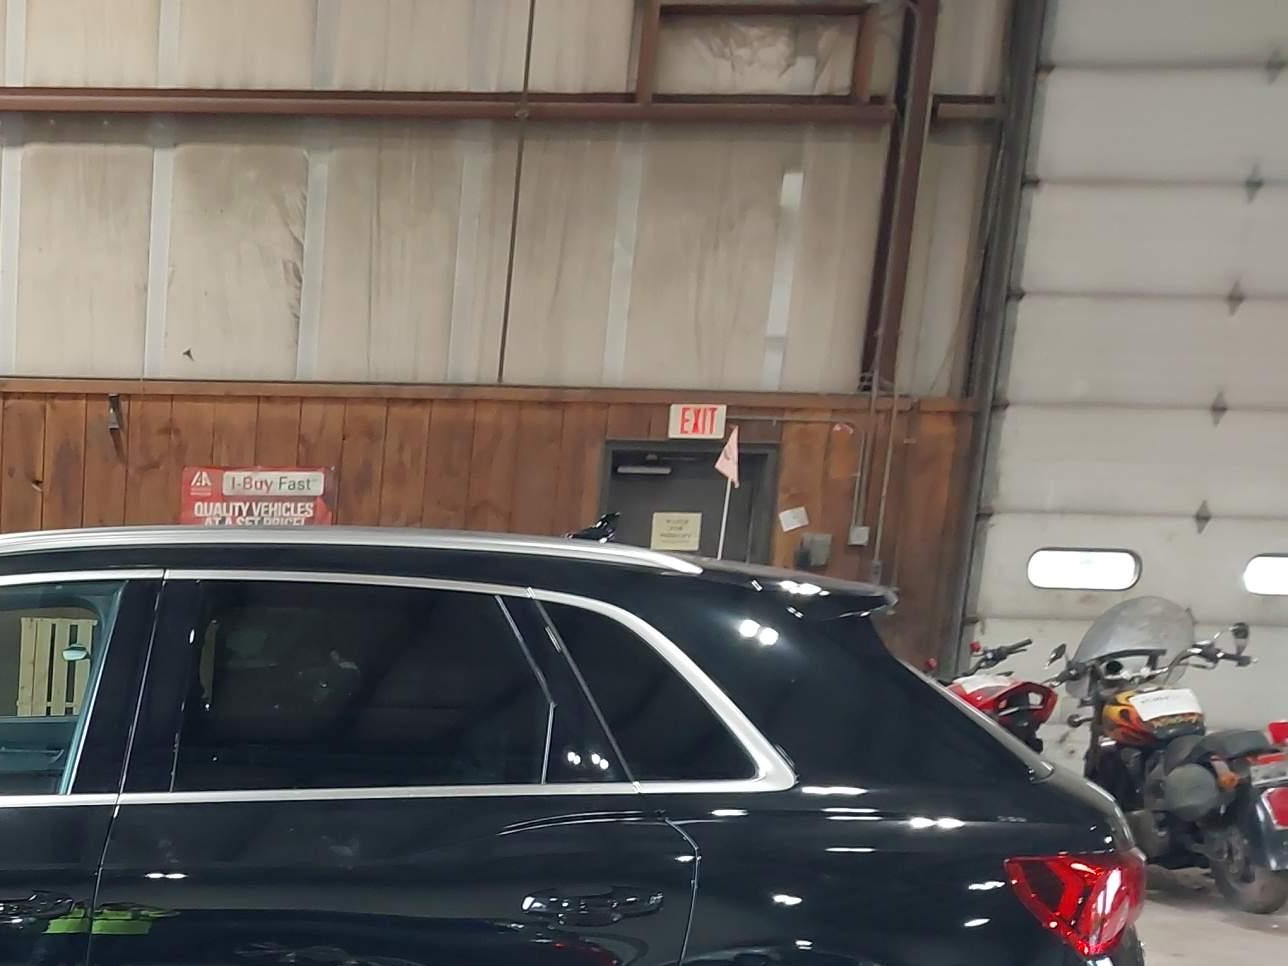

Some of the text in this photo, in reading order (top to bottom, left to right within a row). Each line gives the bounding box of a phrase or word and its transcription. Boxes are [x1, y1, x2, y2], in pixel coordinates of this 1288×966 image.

[679, 407, 718, 434] EXIT
[231, 476, 273, 493] I-Buy
[278, 476, 312, 491] Fast
[194, 501, 314, 517] QUALITY VEHICLES
